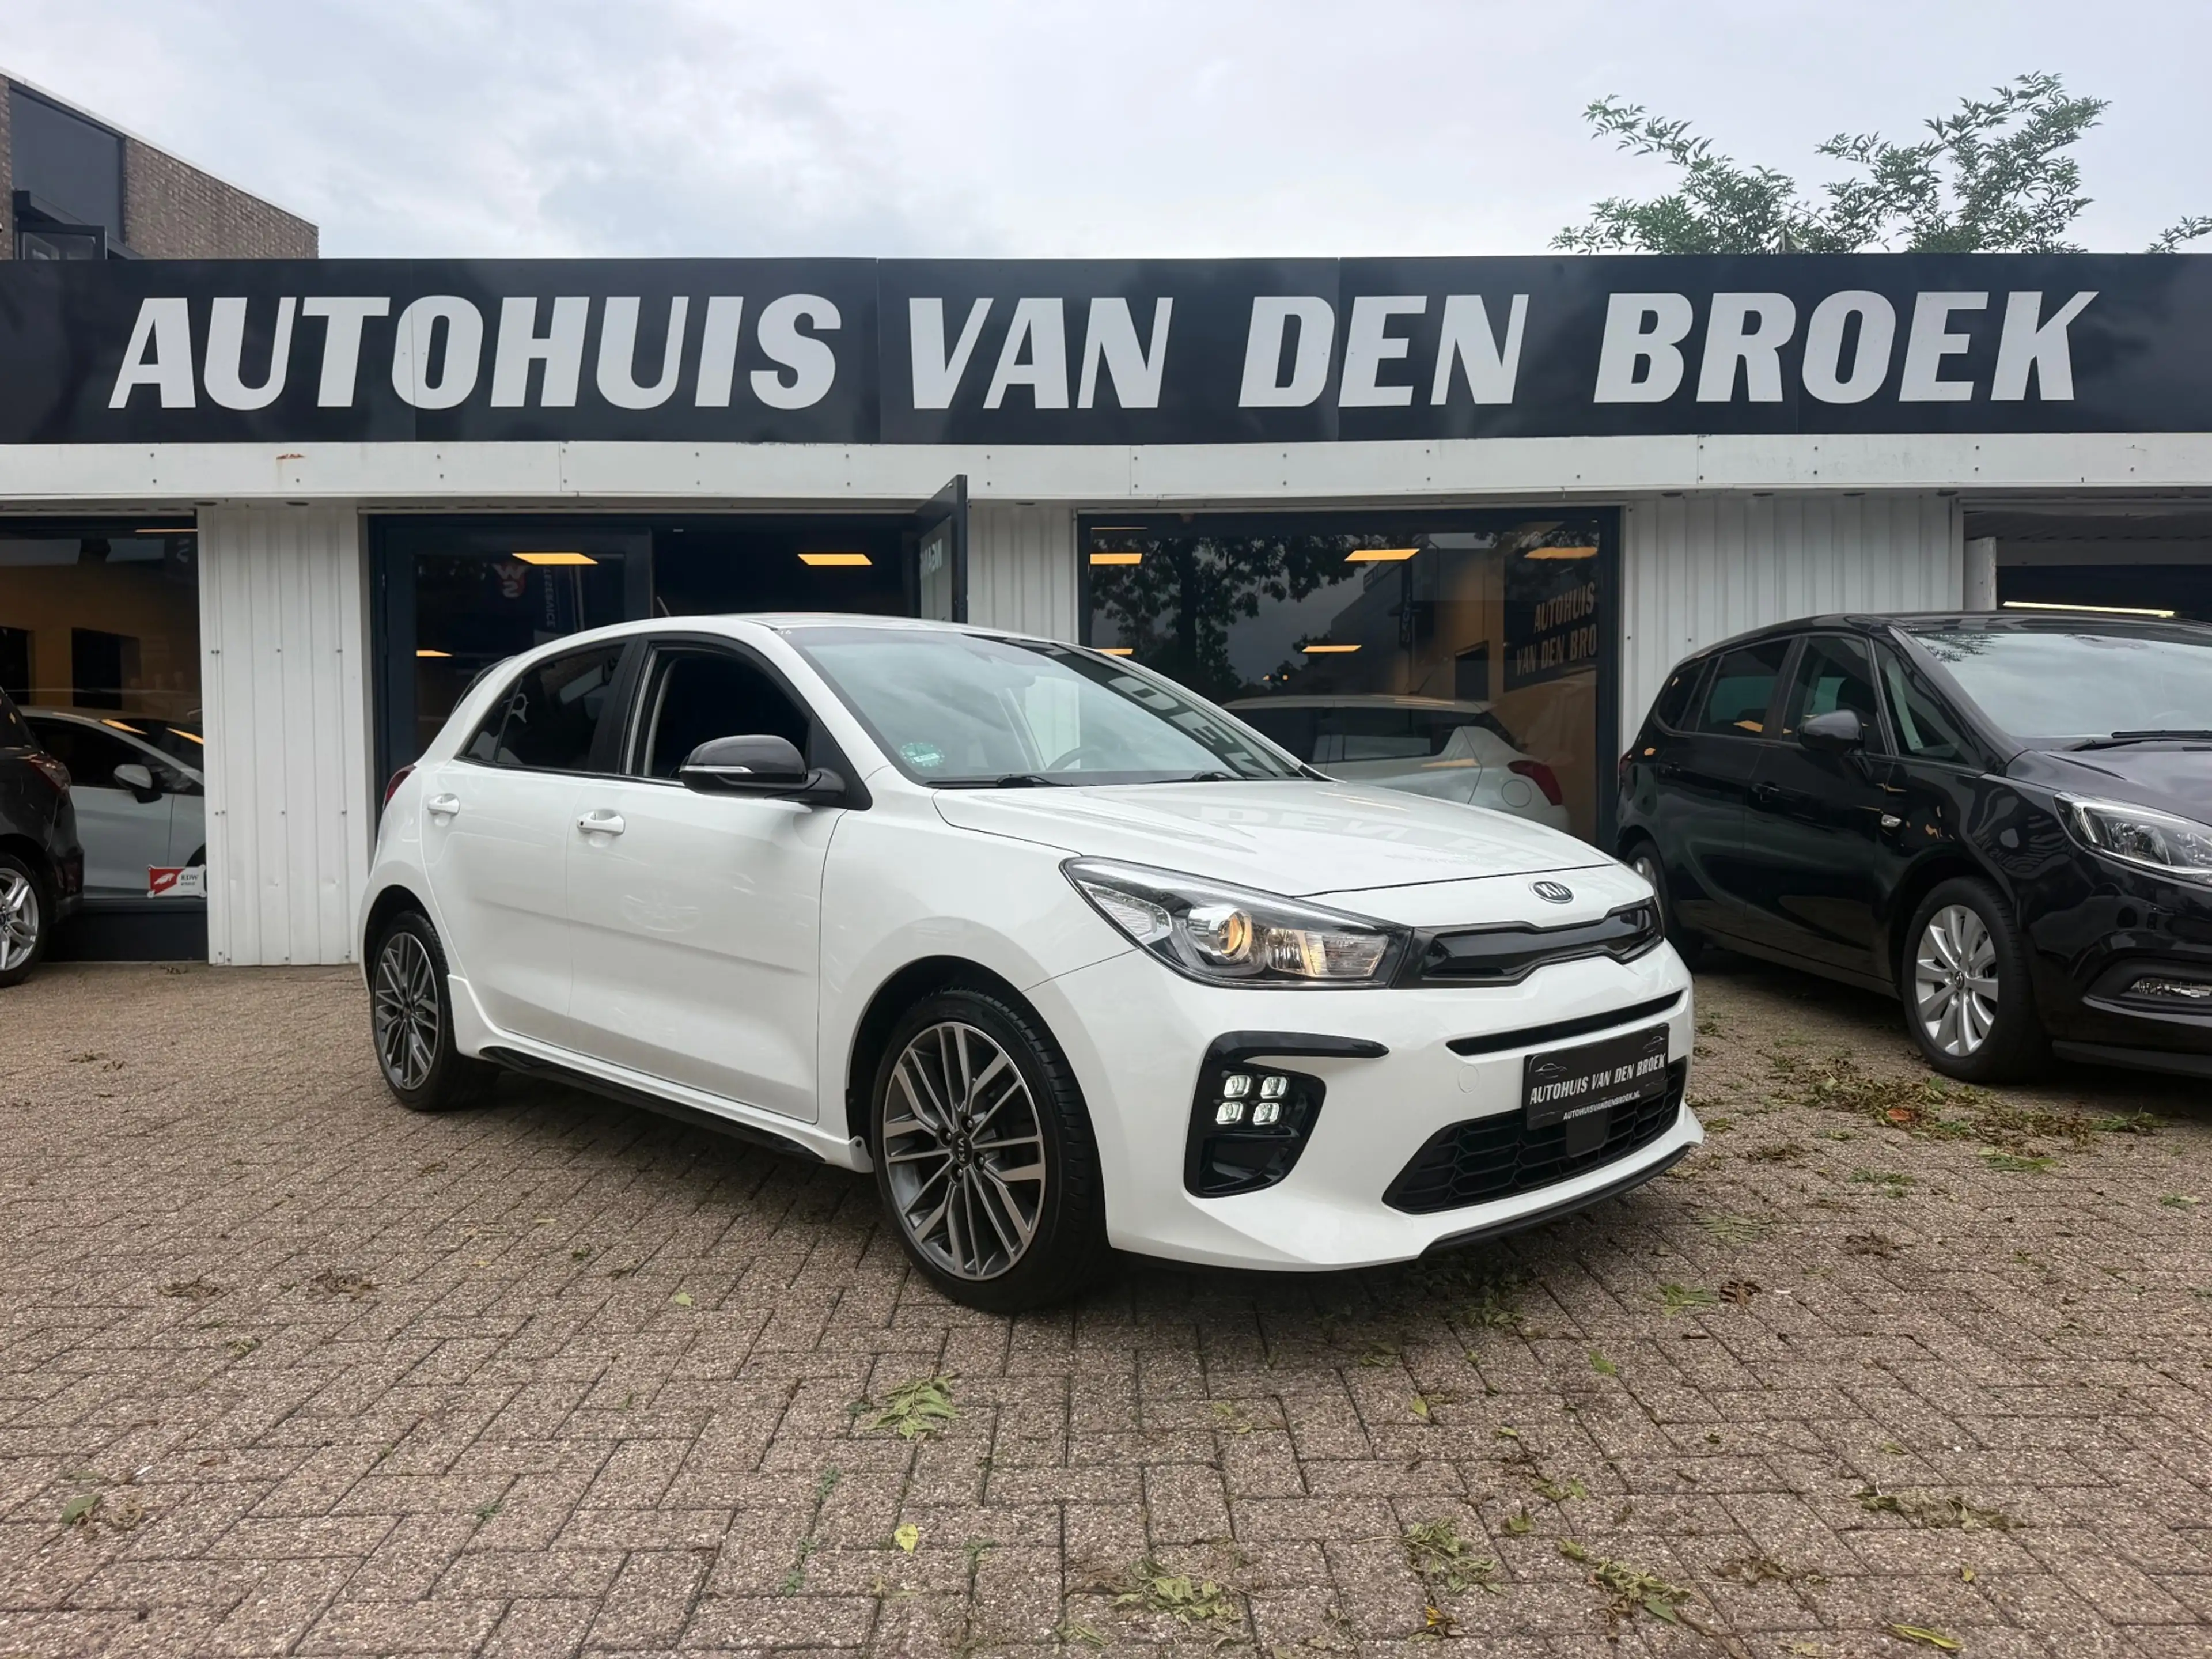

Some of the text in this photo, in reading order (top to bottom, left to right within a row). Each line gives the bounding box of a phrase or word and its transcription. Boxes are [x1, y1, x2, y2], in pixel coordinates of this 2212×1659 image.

[109, 291, 2098, 410] AUTOHUIS VAN DEN BROEK
[1534, 581, 1595, 633] AUTOHUIS
[1517, 623, 1597, 676] VAN DEN BRO
[1536, 883, 1571, 897] KIA
[1530, 1053, 1666, 1105] AUTOHUIS VAN DEN BROEK
[957, 1138, 965, 1162] KIA
